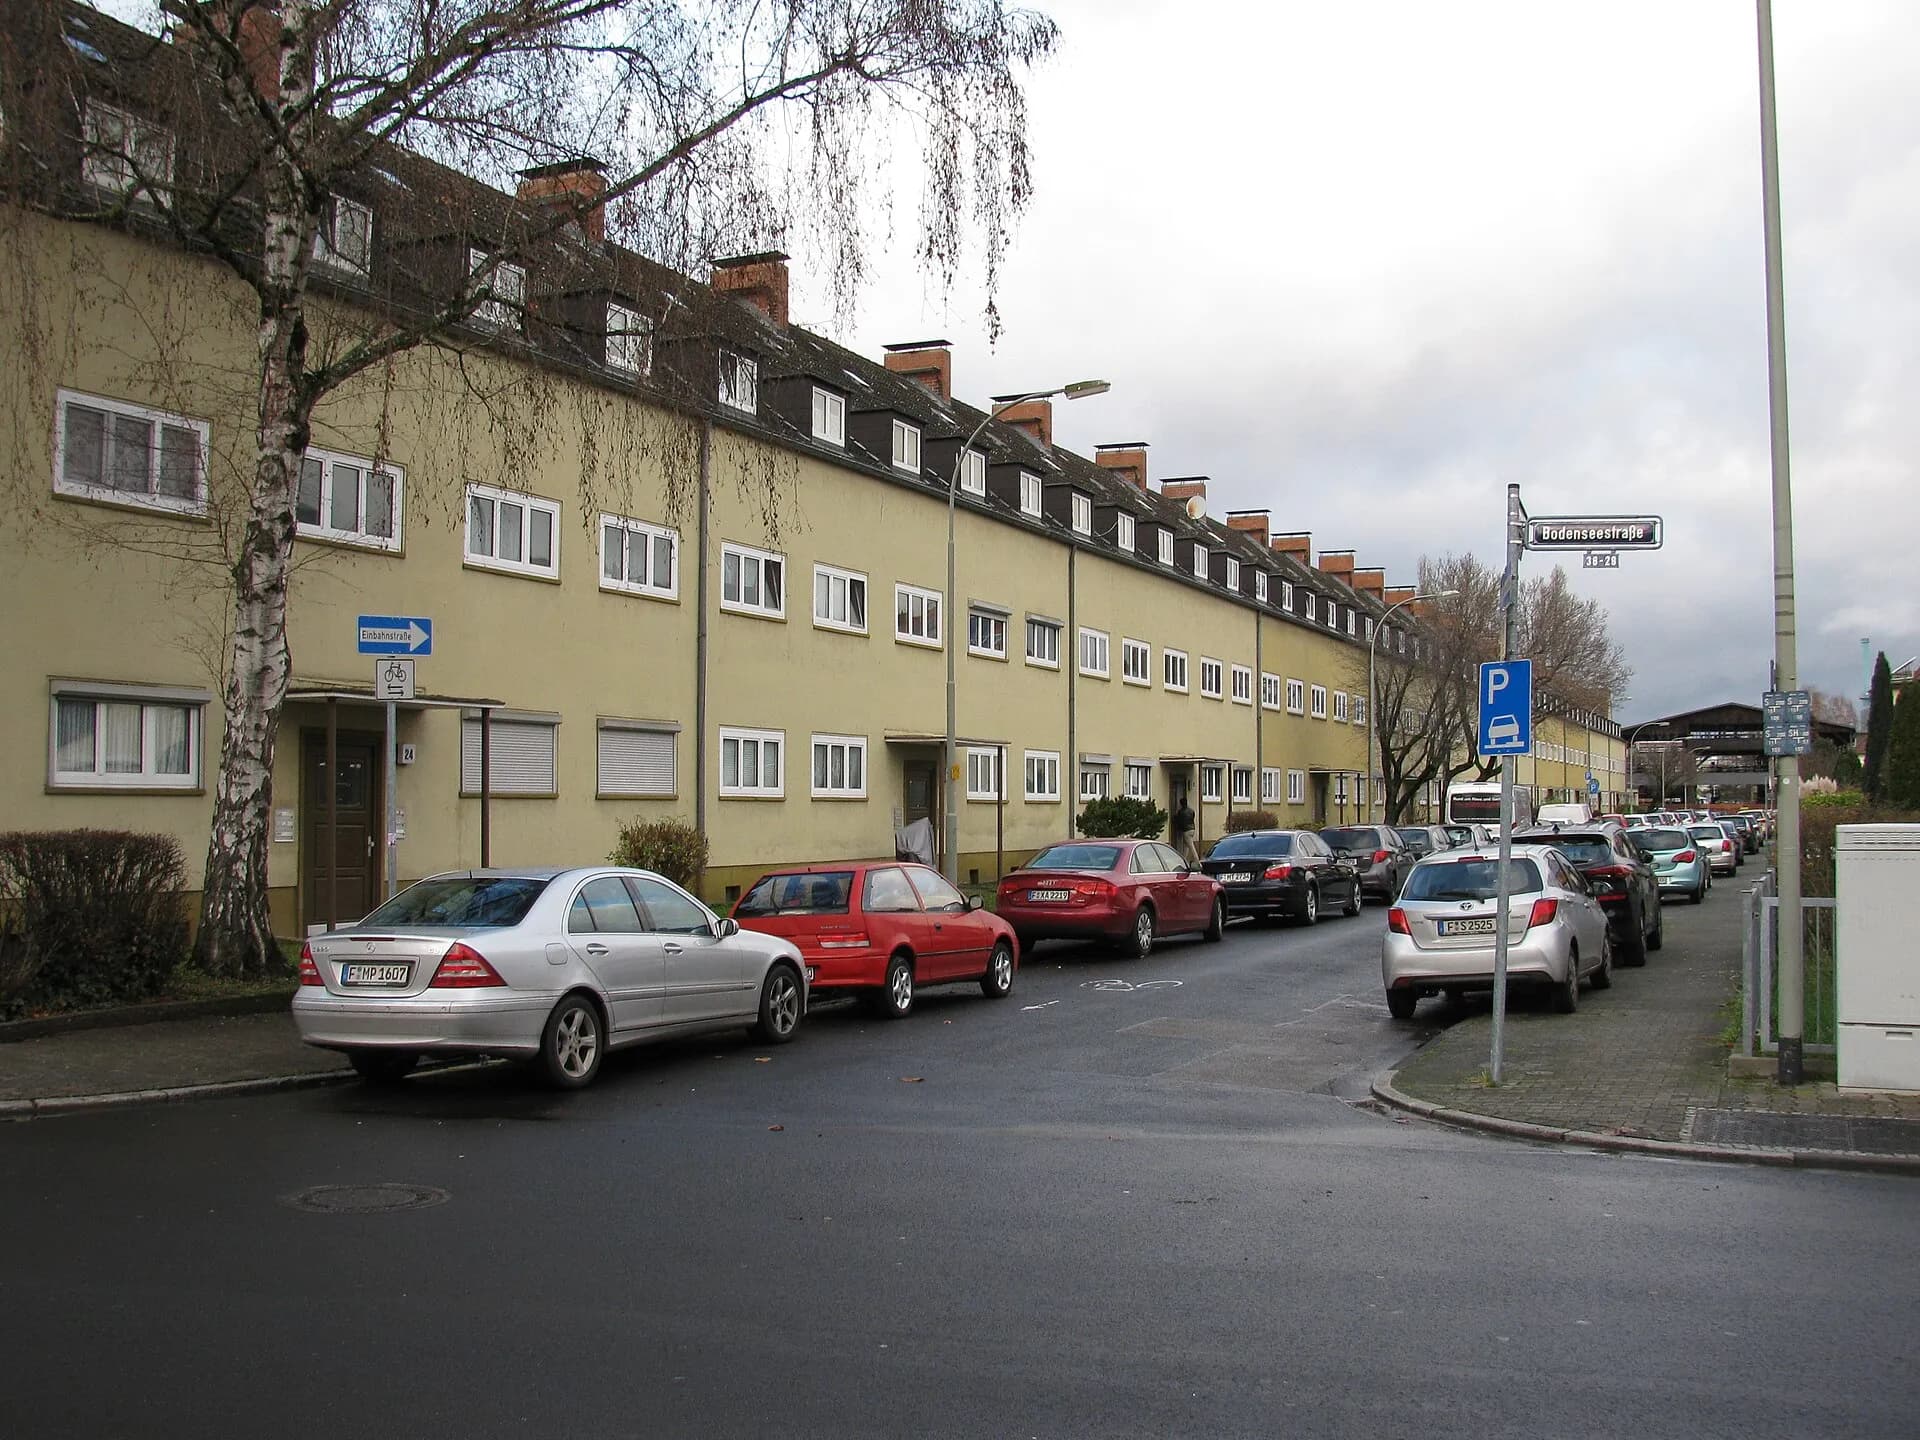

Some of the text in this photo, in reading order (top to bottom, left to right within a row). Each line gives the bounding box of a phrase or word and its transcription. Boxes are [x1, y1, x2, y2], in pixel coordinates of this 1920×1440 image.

[1542, 524, 1644, 542] Bodenseestraße
[361, 630, 412, 641] Einbahnstraße
[1488, 668, 1509, 705] P
[1764, 698, 1769, 706] S
[1765, 730, 1770, 738] S
[1788, 729, 1799, 737] SH
[404, 748, 413, 761] 24
[1468, 919, 1493, 931] 2525
[362, 966, 376, 980] MP
[379, 965, 406, 980] 1607
